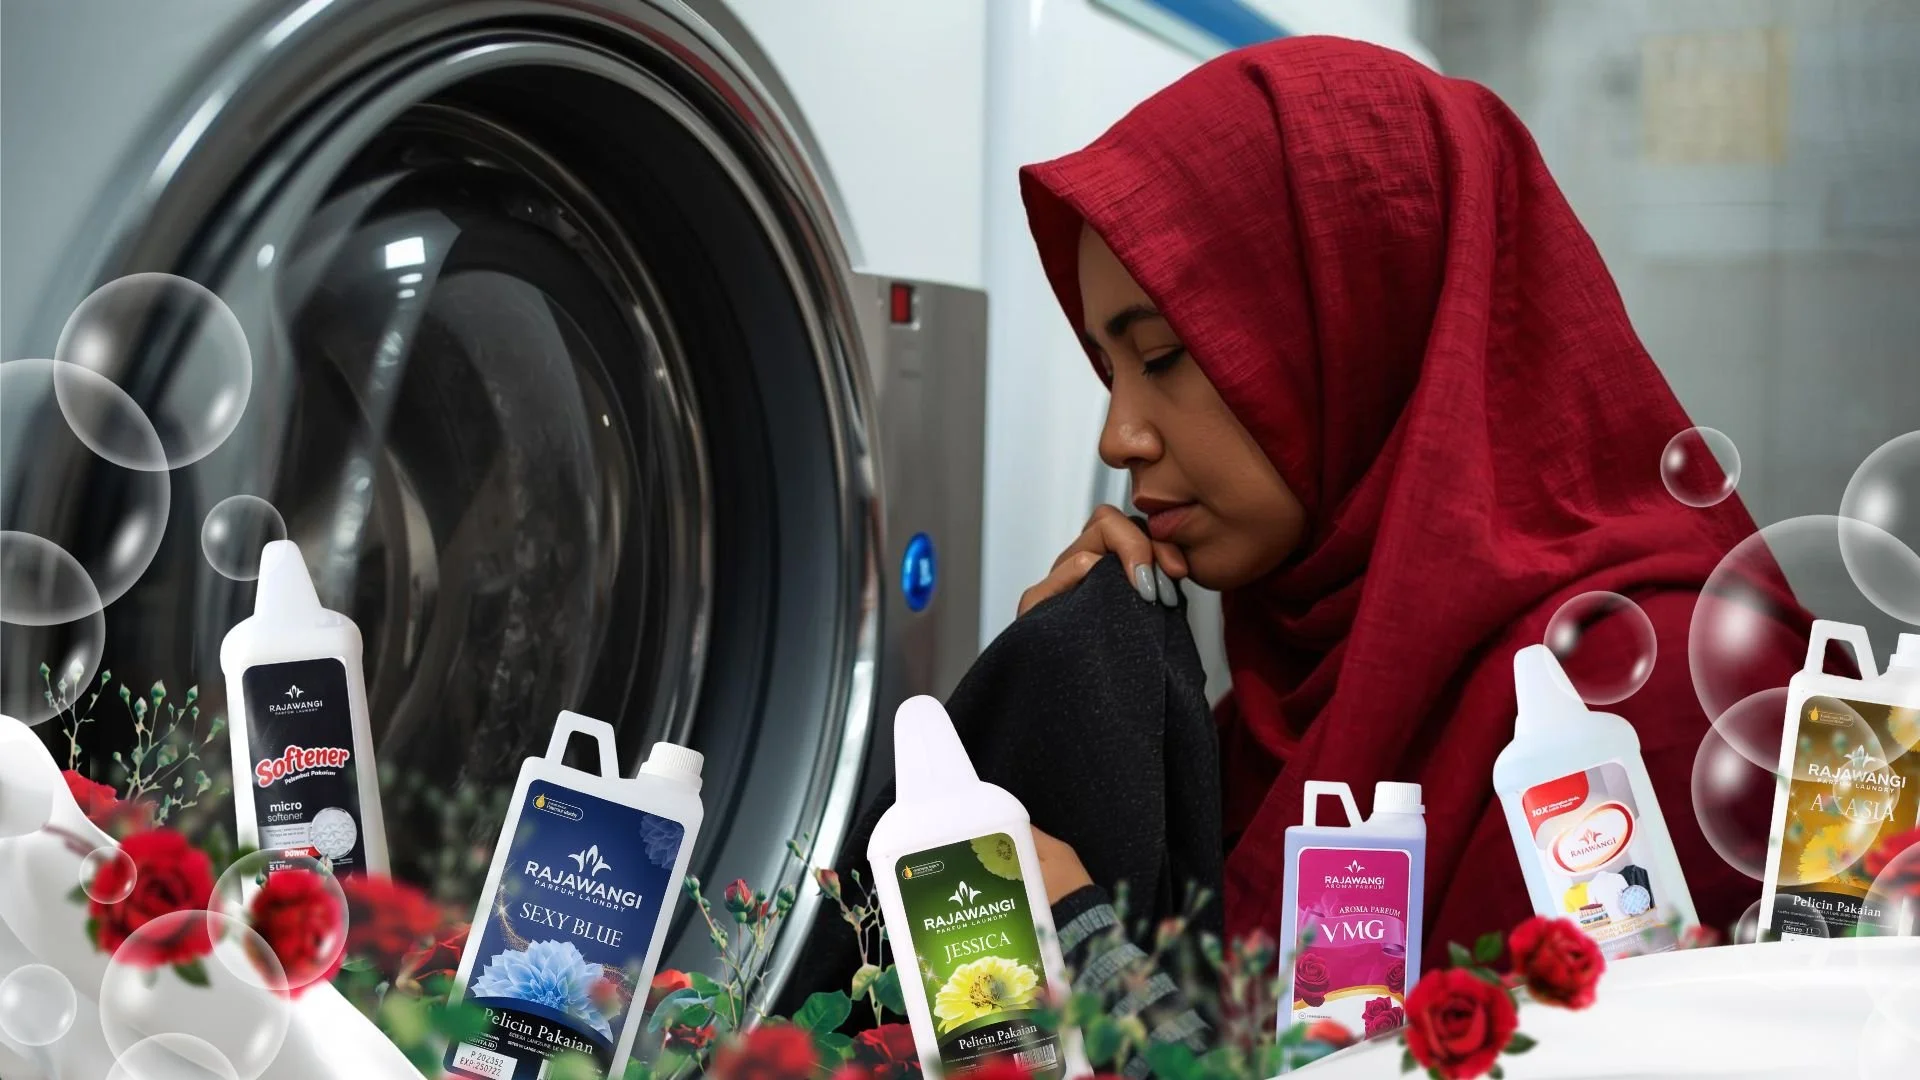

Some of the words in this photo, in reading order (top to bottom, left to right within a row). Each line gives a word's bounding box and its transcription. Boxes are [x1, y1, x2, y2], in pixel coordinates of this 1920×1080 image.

[269, 700, 323, 713] RAJAWANGI
[255, 745, 350, 788] Softener
[1808, 763, 1906, 789] RAJAWANGI
[1817, 777, 1852, 786] PARF
[1855, 784, 1895, 793] LAUNDRY
[268, 811, 304, 823] softener
[270, 801, 302, 812] micro
[1531, 806, 1549, 818] 10X
[1810, 793, 1895, 821] AASIA
[1570, 837, 1617, 858] RAJAWANGI
[525, 861, 643, 910] RAJAWANGI
[1324, 875, 1385, 885] RAJAWANGI
[534, 879, 574, 897] PARFUM
[579, 893, 626, 912] LAUNDRY
[1793, 895, 1833, 911] Pelicin
[1837, 901, 1881, 917] Pakaian
[923, 898, 1016, 931] RAJAWANGI
[1339, 906, 1368, 914] AROMA
[1370, 906, 1401, 917] PARFUM
[519, 902, 571, 930] SEXY
[572, 918, 624, 948] BLUE
[936, 923, 968, 934] PARFUM
[971, 913, 1009, 926] LAUNDRY
[944, 931, 1011, 964] JESSICA
[484, 1007, 533, 1036] Pelicin
[537, 1025, 594, 1055] Pakaian
[958, 1033, 995, 1050] Pelicin
[997, 1025, 1038, 1041] Pakaian
